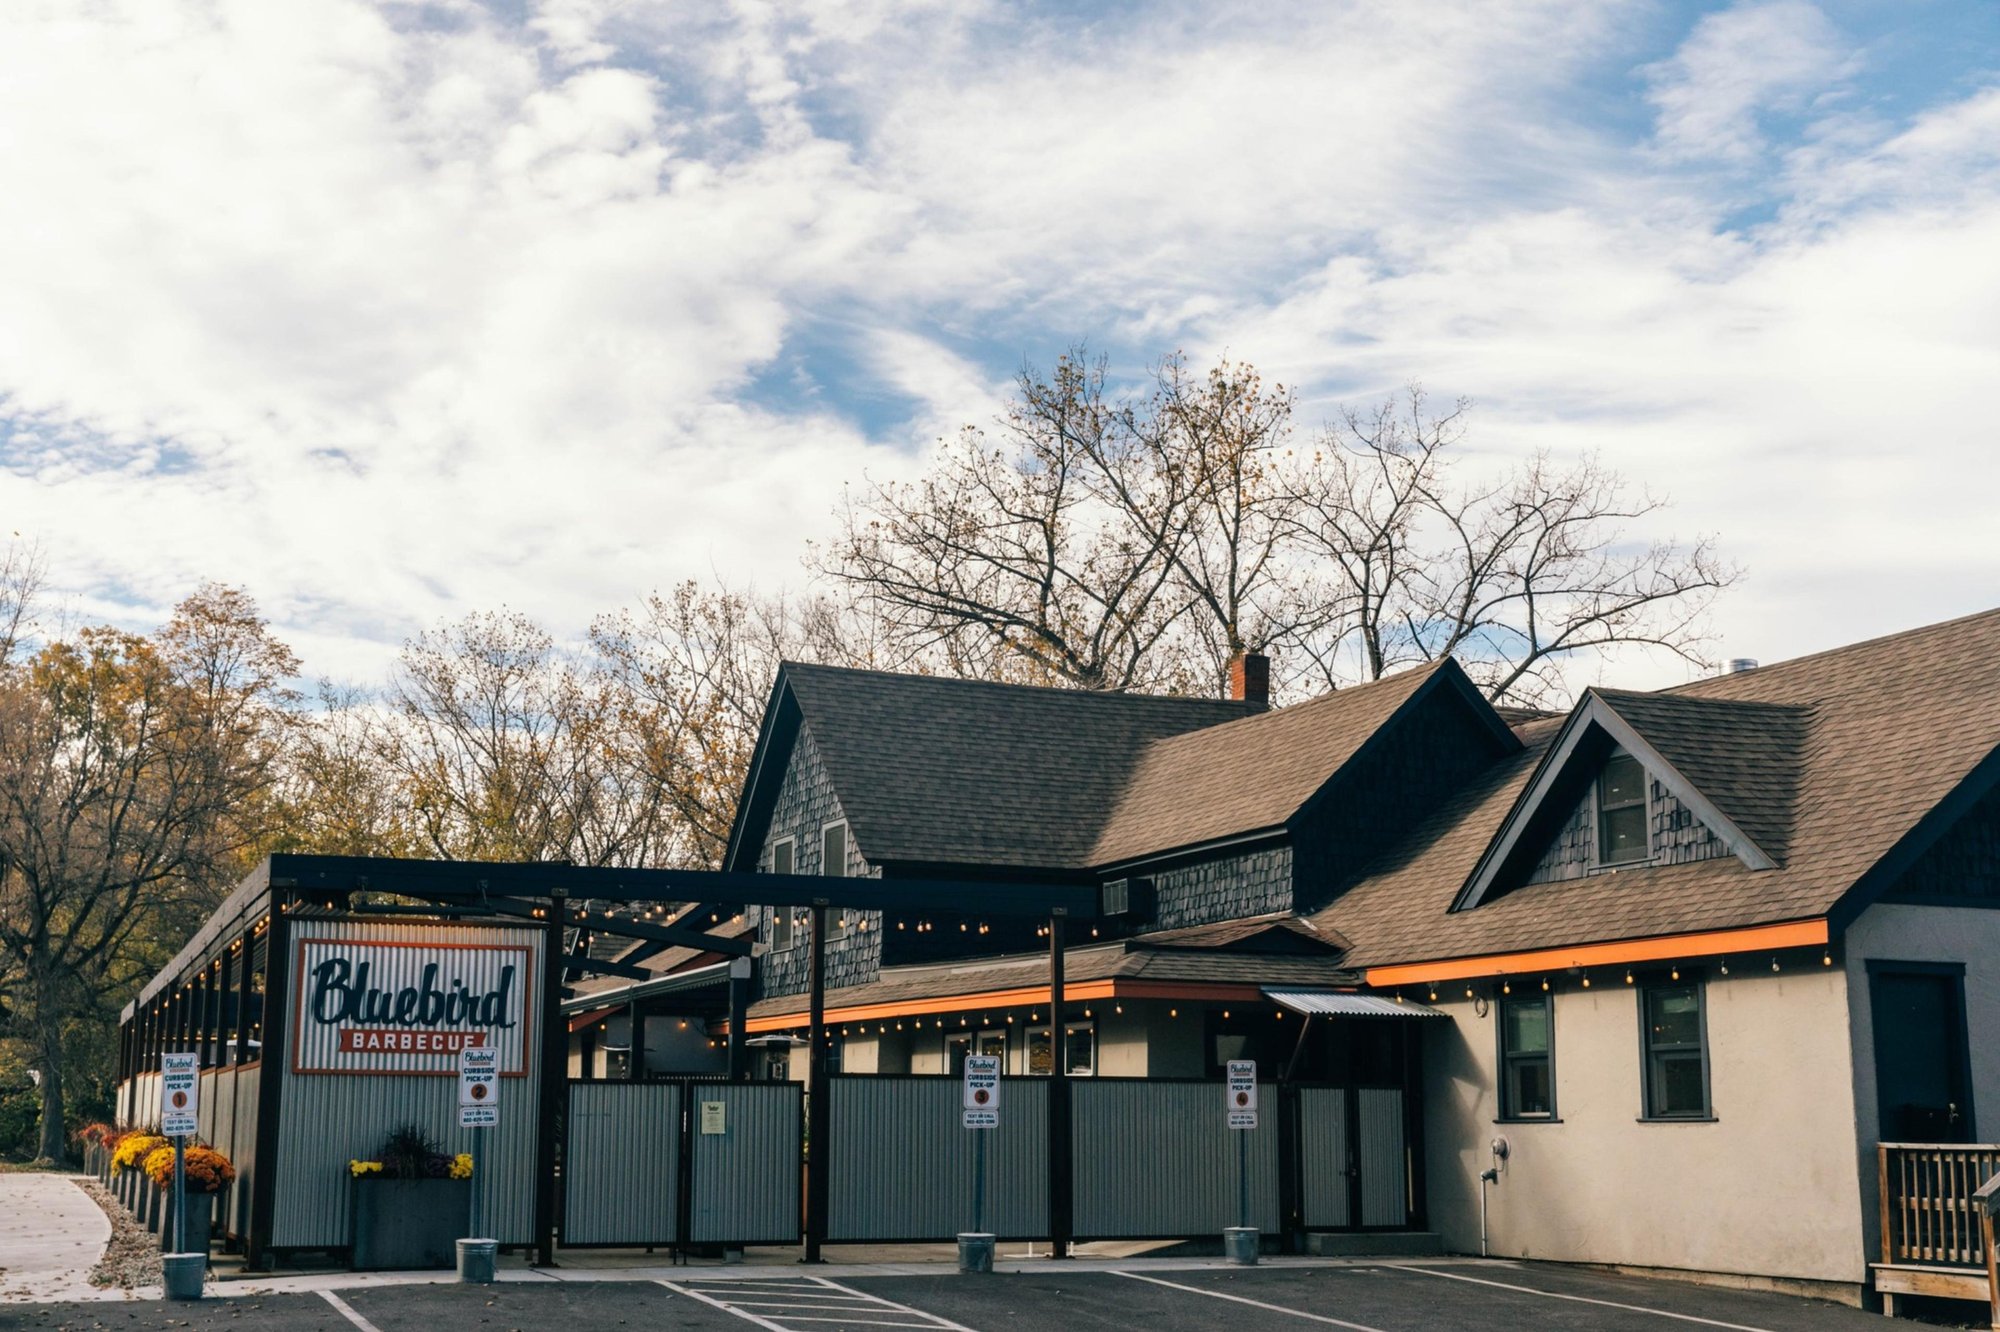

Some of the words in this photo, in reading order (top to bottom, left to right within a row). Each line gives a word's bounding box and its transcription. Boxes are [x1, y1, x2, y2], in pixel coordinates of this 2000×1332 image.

[312, 958, 516, 1029] Bluebird
[352, 1032, 475, 1050] BARBECUE
[165, 1073, 194, 1082] CURBSIDE
